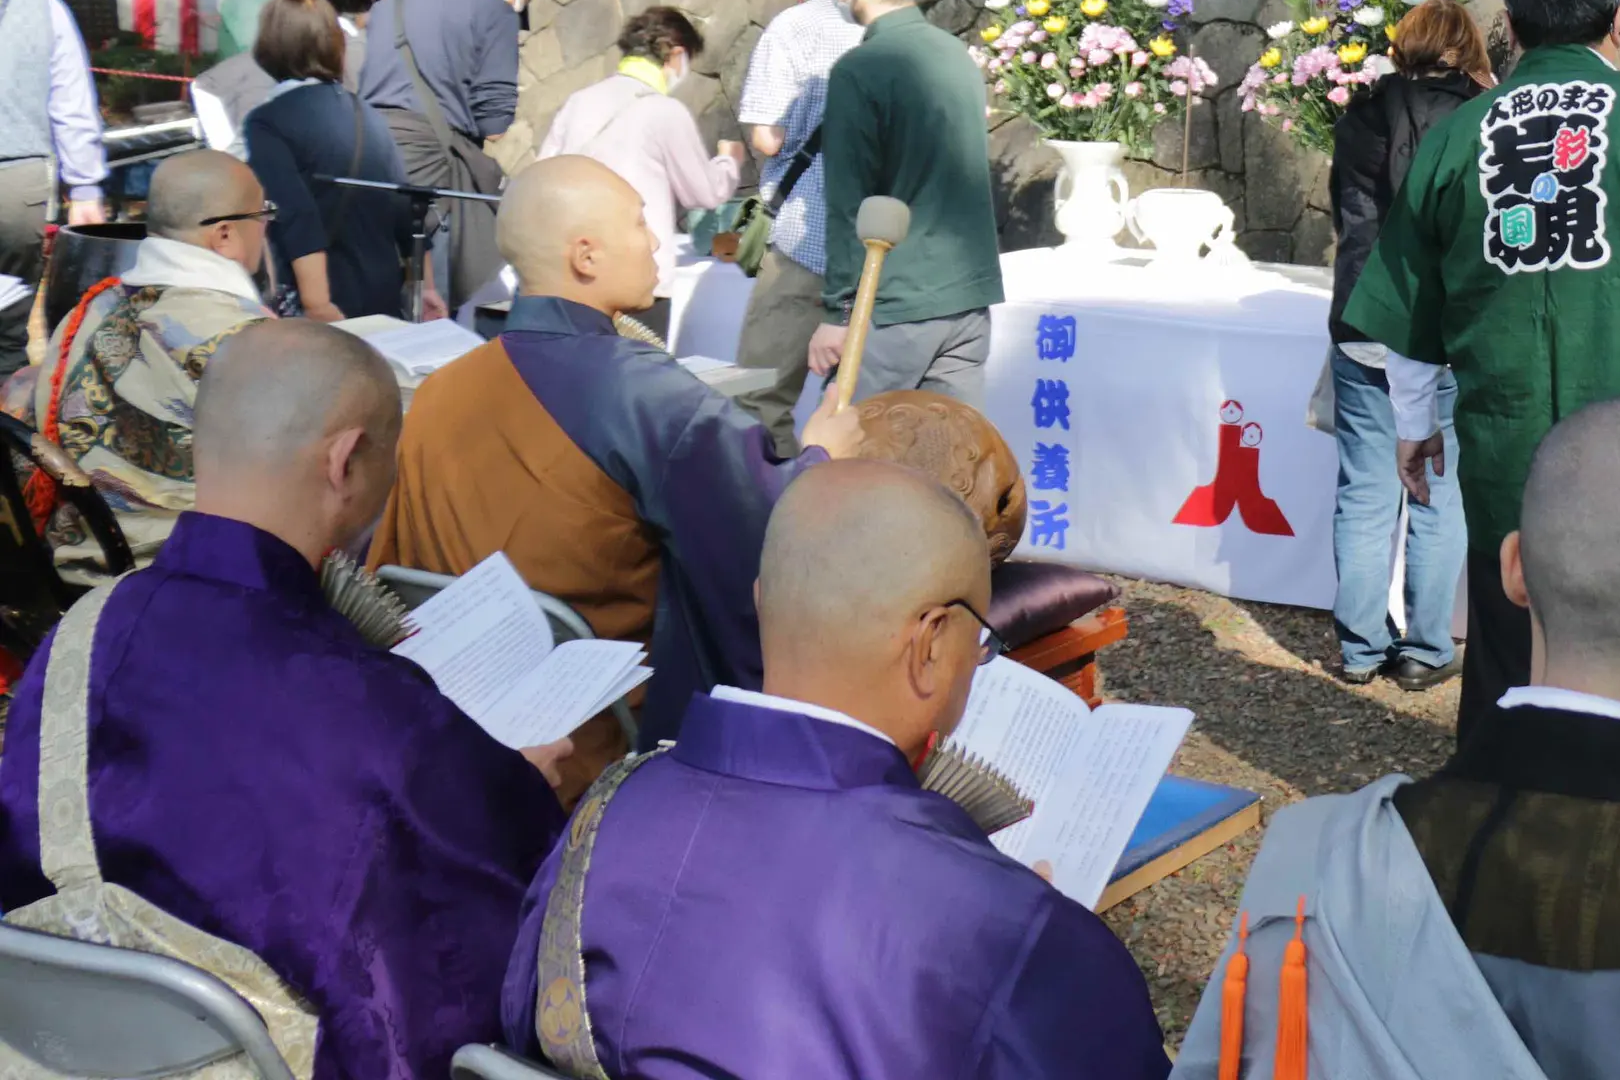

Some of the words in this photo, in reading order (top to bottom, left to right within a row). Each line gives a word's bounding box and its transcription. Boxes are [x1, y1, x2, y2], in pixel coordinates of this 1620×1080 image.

[1486, 85, 1610, 128] 人形のまち
[1029, 313, 1077, 551] 御供養所
